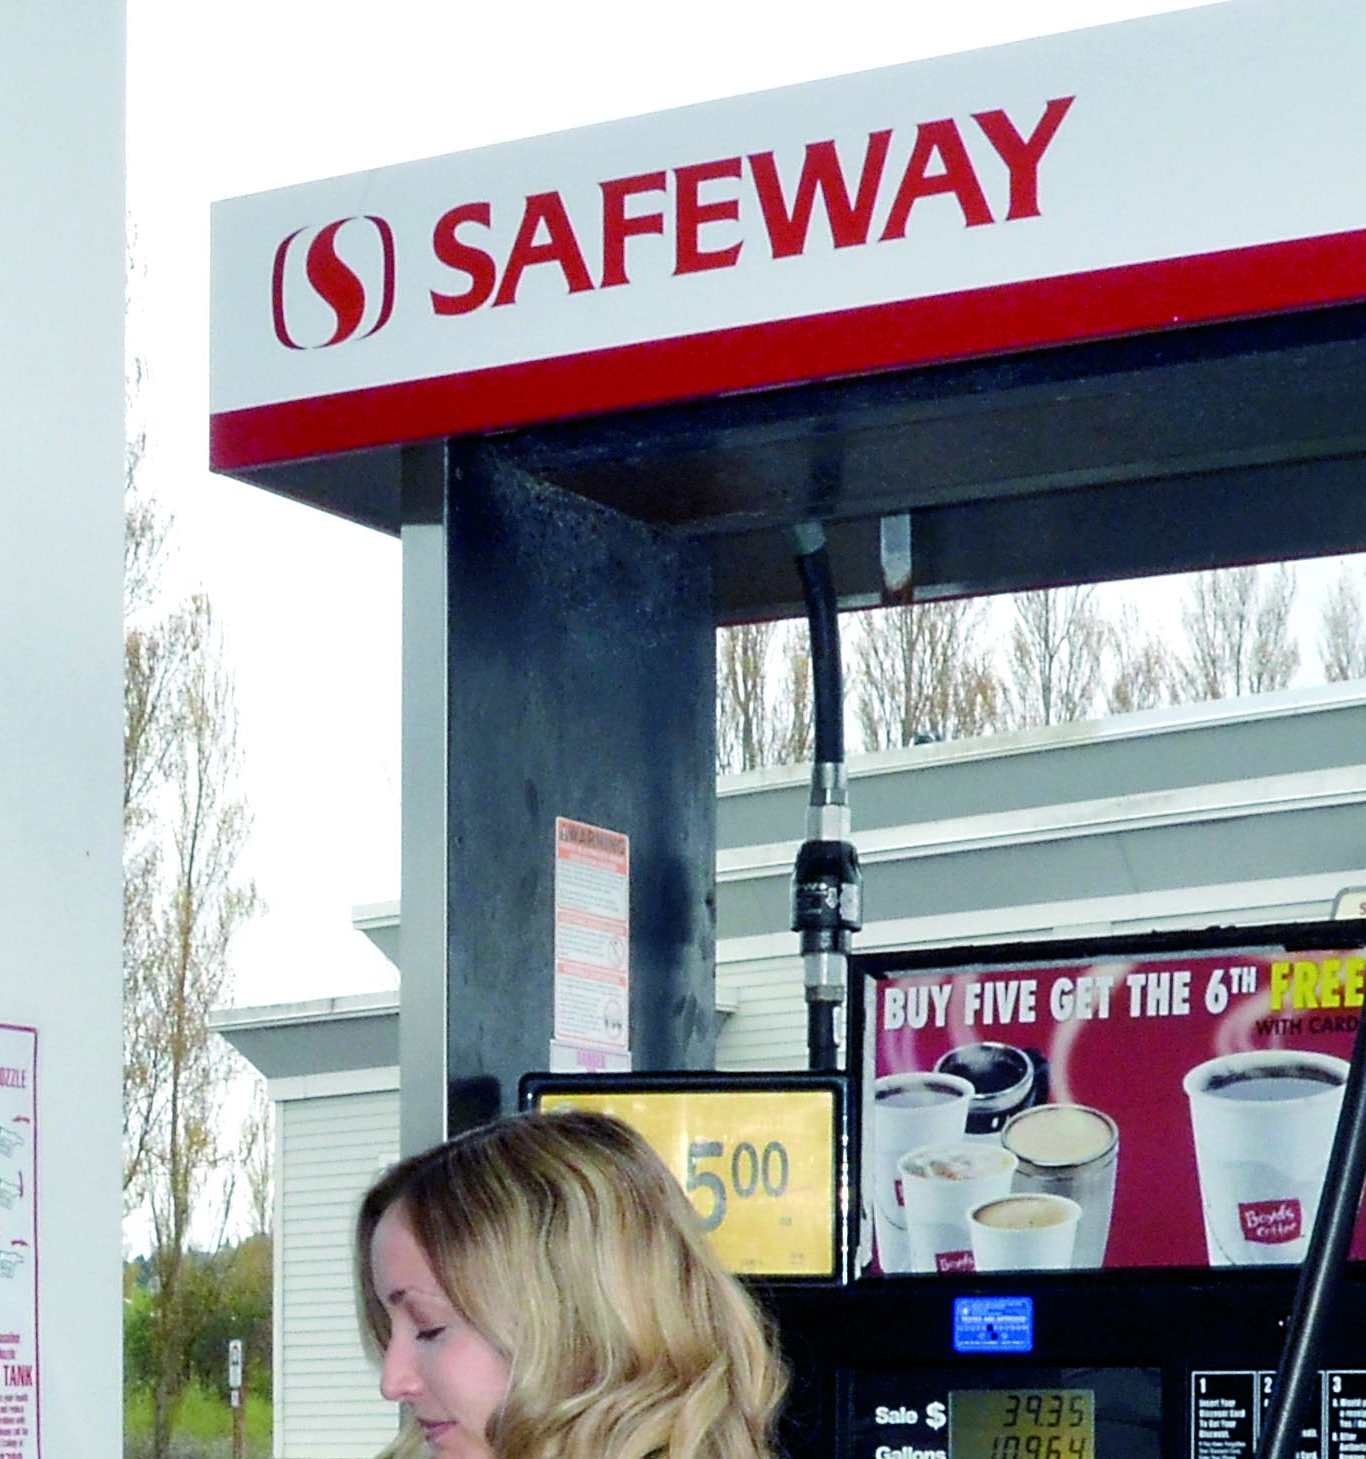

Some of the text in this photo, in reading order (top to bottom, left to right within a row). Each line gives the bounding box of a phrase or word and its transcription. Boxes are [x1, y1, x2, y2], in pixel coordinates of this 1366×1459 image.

[428, 96, 1075, 316] SAFEWAY
[884, 957, 1366, 1030] BUY FIVE GET THE 6TH FREE
[1255, 1015, 1359, 1035] WITH CARD
[4, 1365, 33, 1386] TANK
[1200, 1377, 1206, 1394] 1
[1264, 1377, 1272, 1393] 2
[1333, 1376, 1341, 1393] 3
[875, 1400, 947, 1431] Sale $
